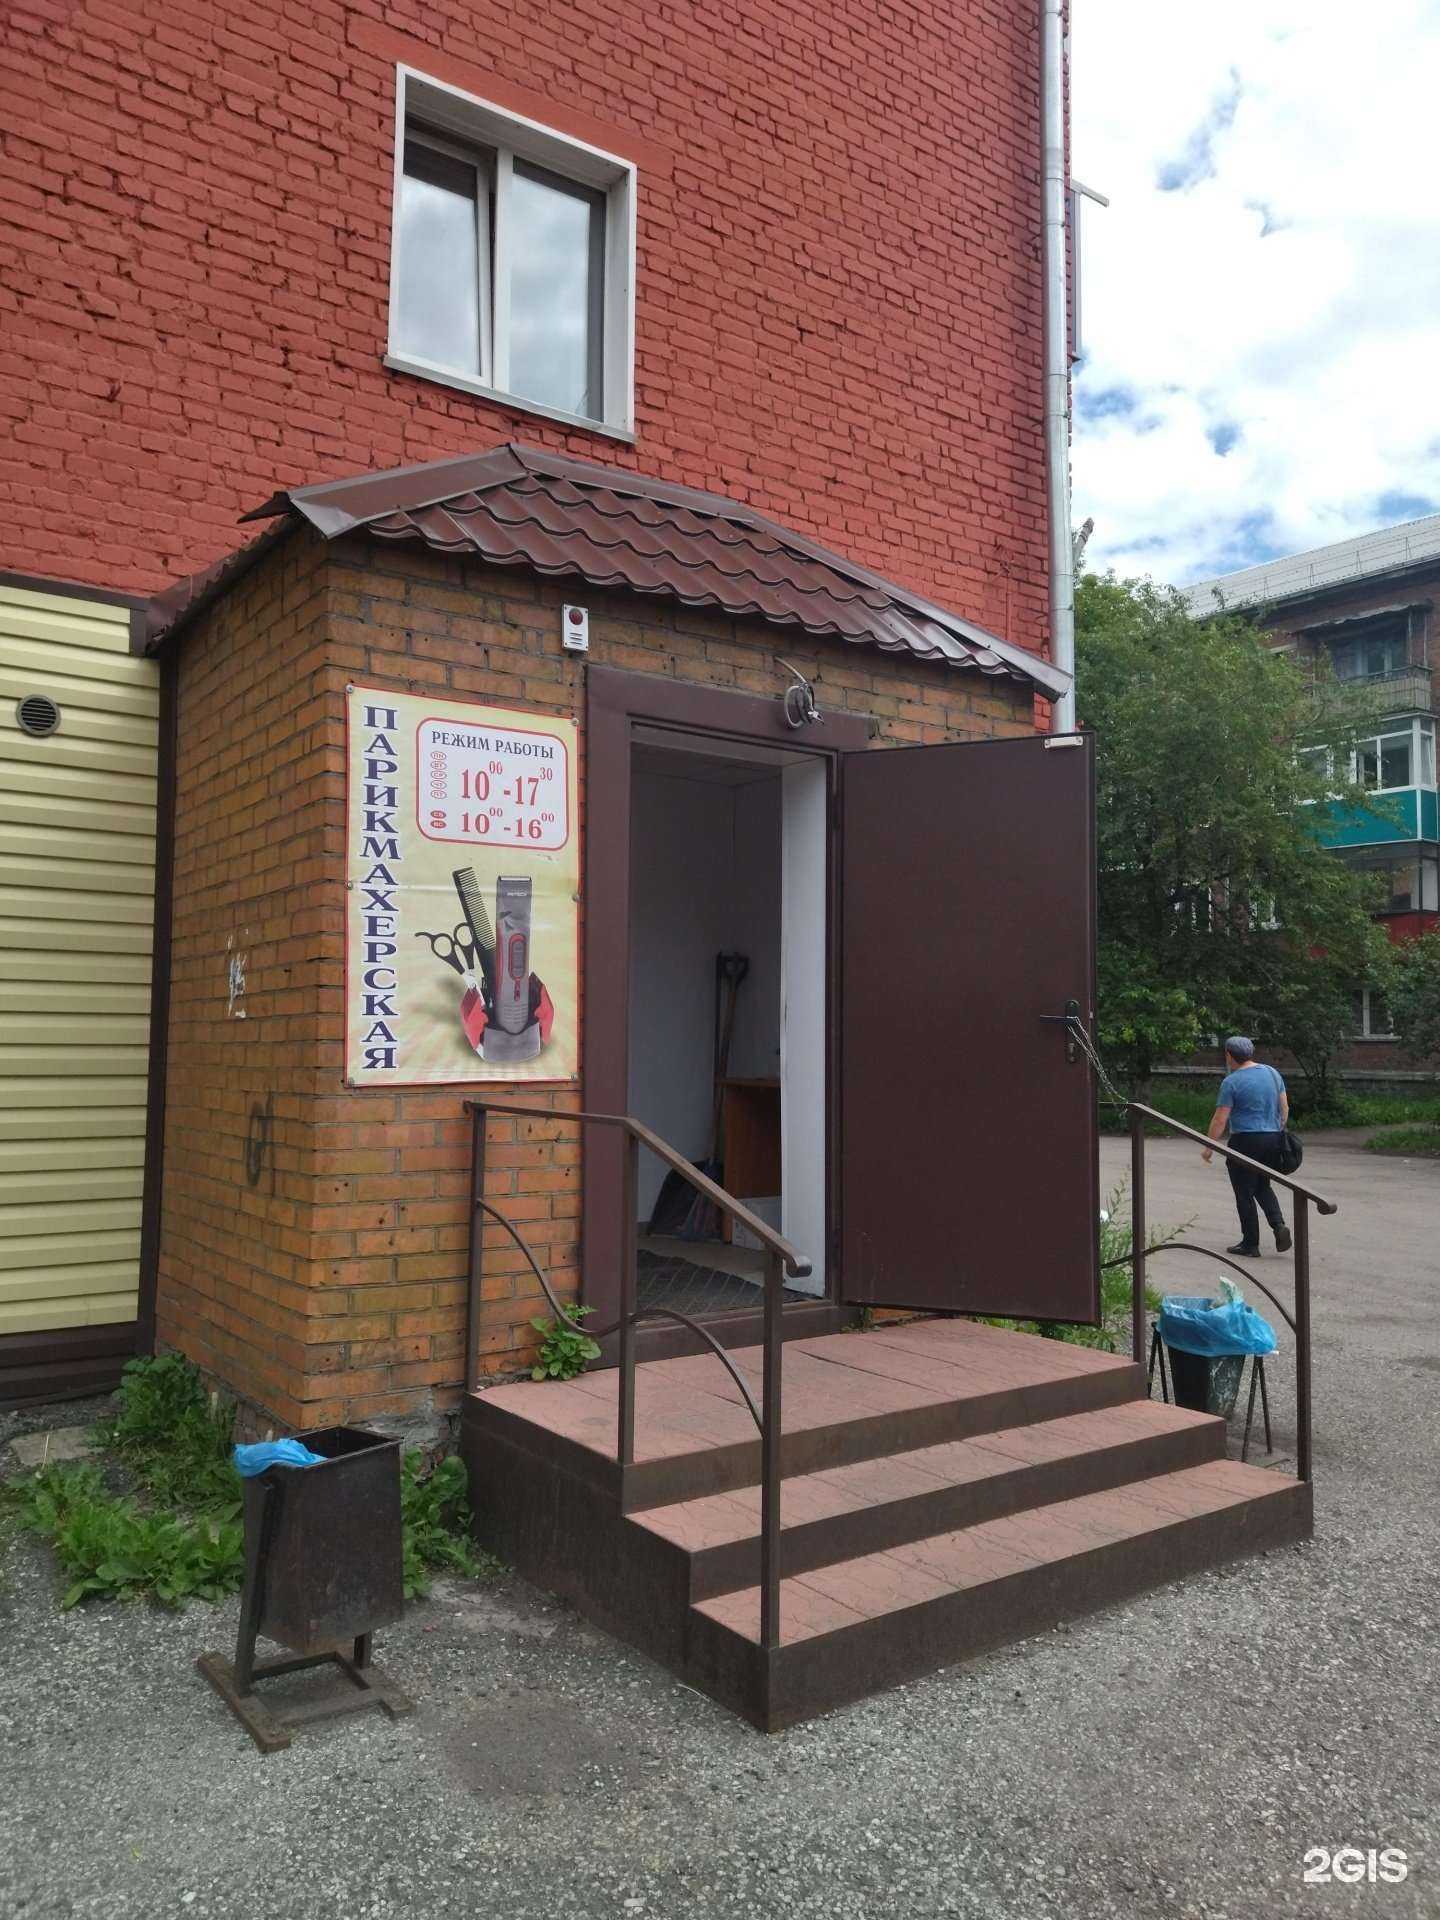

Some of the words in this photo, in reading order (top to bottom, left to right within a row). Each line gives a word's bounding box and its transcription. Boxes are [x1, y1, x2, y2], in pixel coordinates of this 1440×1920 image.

[431, 730, 490, 751] РЕЖИМ
[495, 739, 554, 759] РАБОТЫ
[360, 705, 401, 1069] ПАРИКМАХЕРСКАЯ
